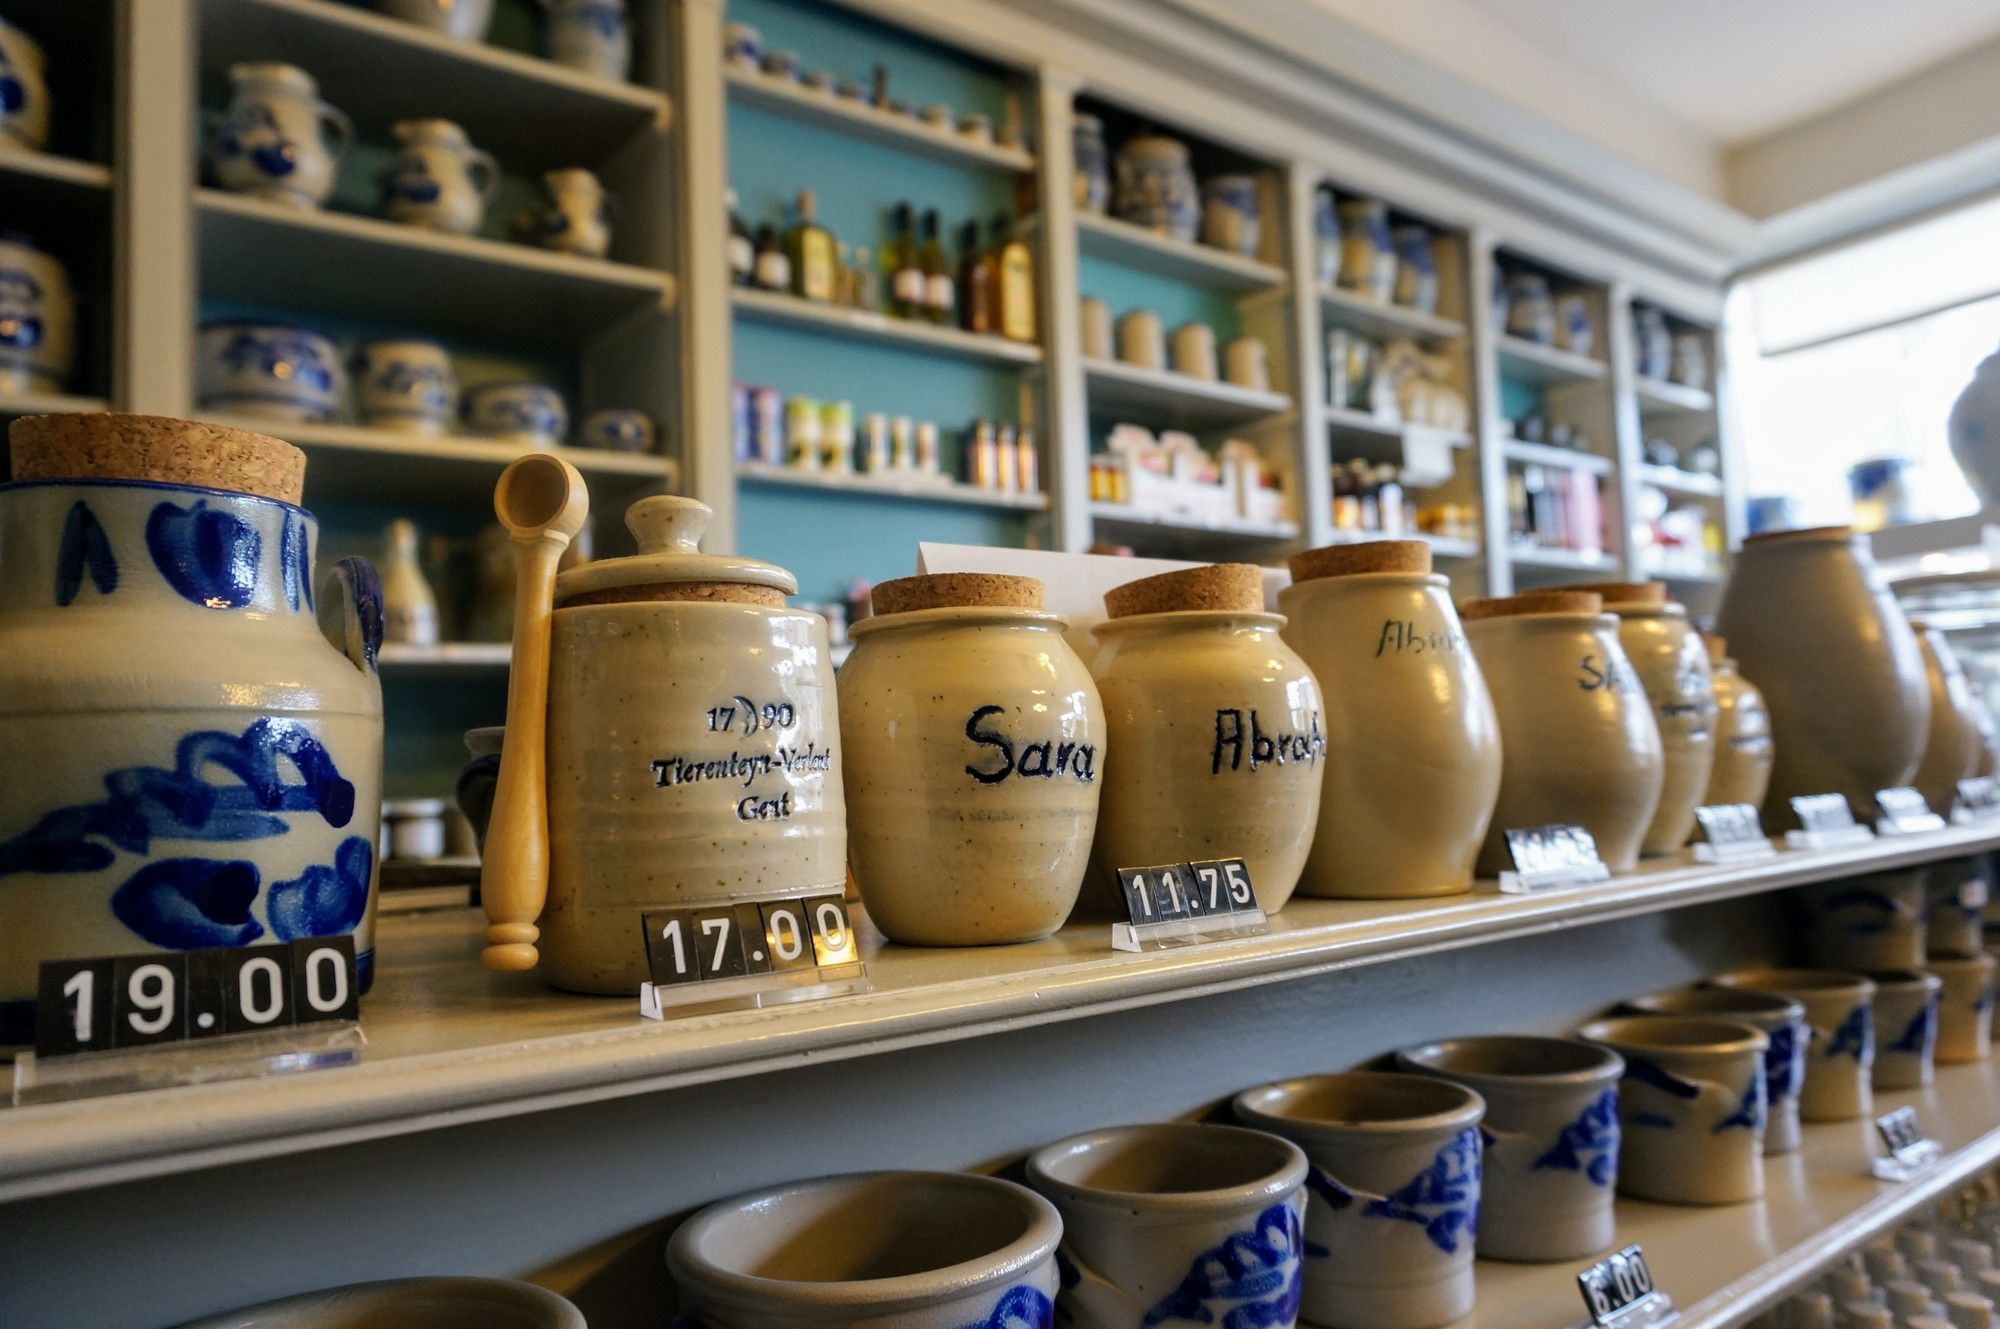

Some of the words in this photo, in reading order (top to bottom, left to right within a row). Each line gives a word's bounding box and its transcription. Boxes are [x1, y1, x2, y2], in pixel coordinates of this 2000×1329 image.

[964, 704, 1096, 785] Sara
[736, 791, 791, 823] Gent
[1131, 862, 1250, 917] 11.75
[661, 902, 847, 975] 17.00
[63, 947, 349, 1043] 19.00
[1589, 1254, 1651, 1316] 6.00
